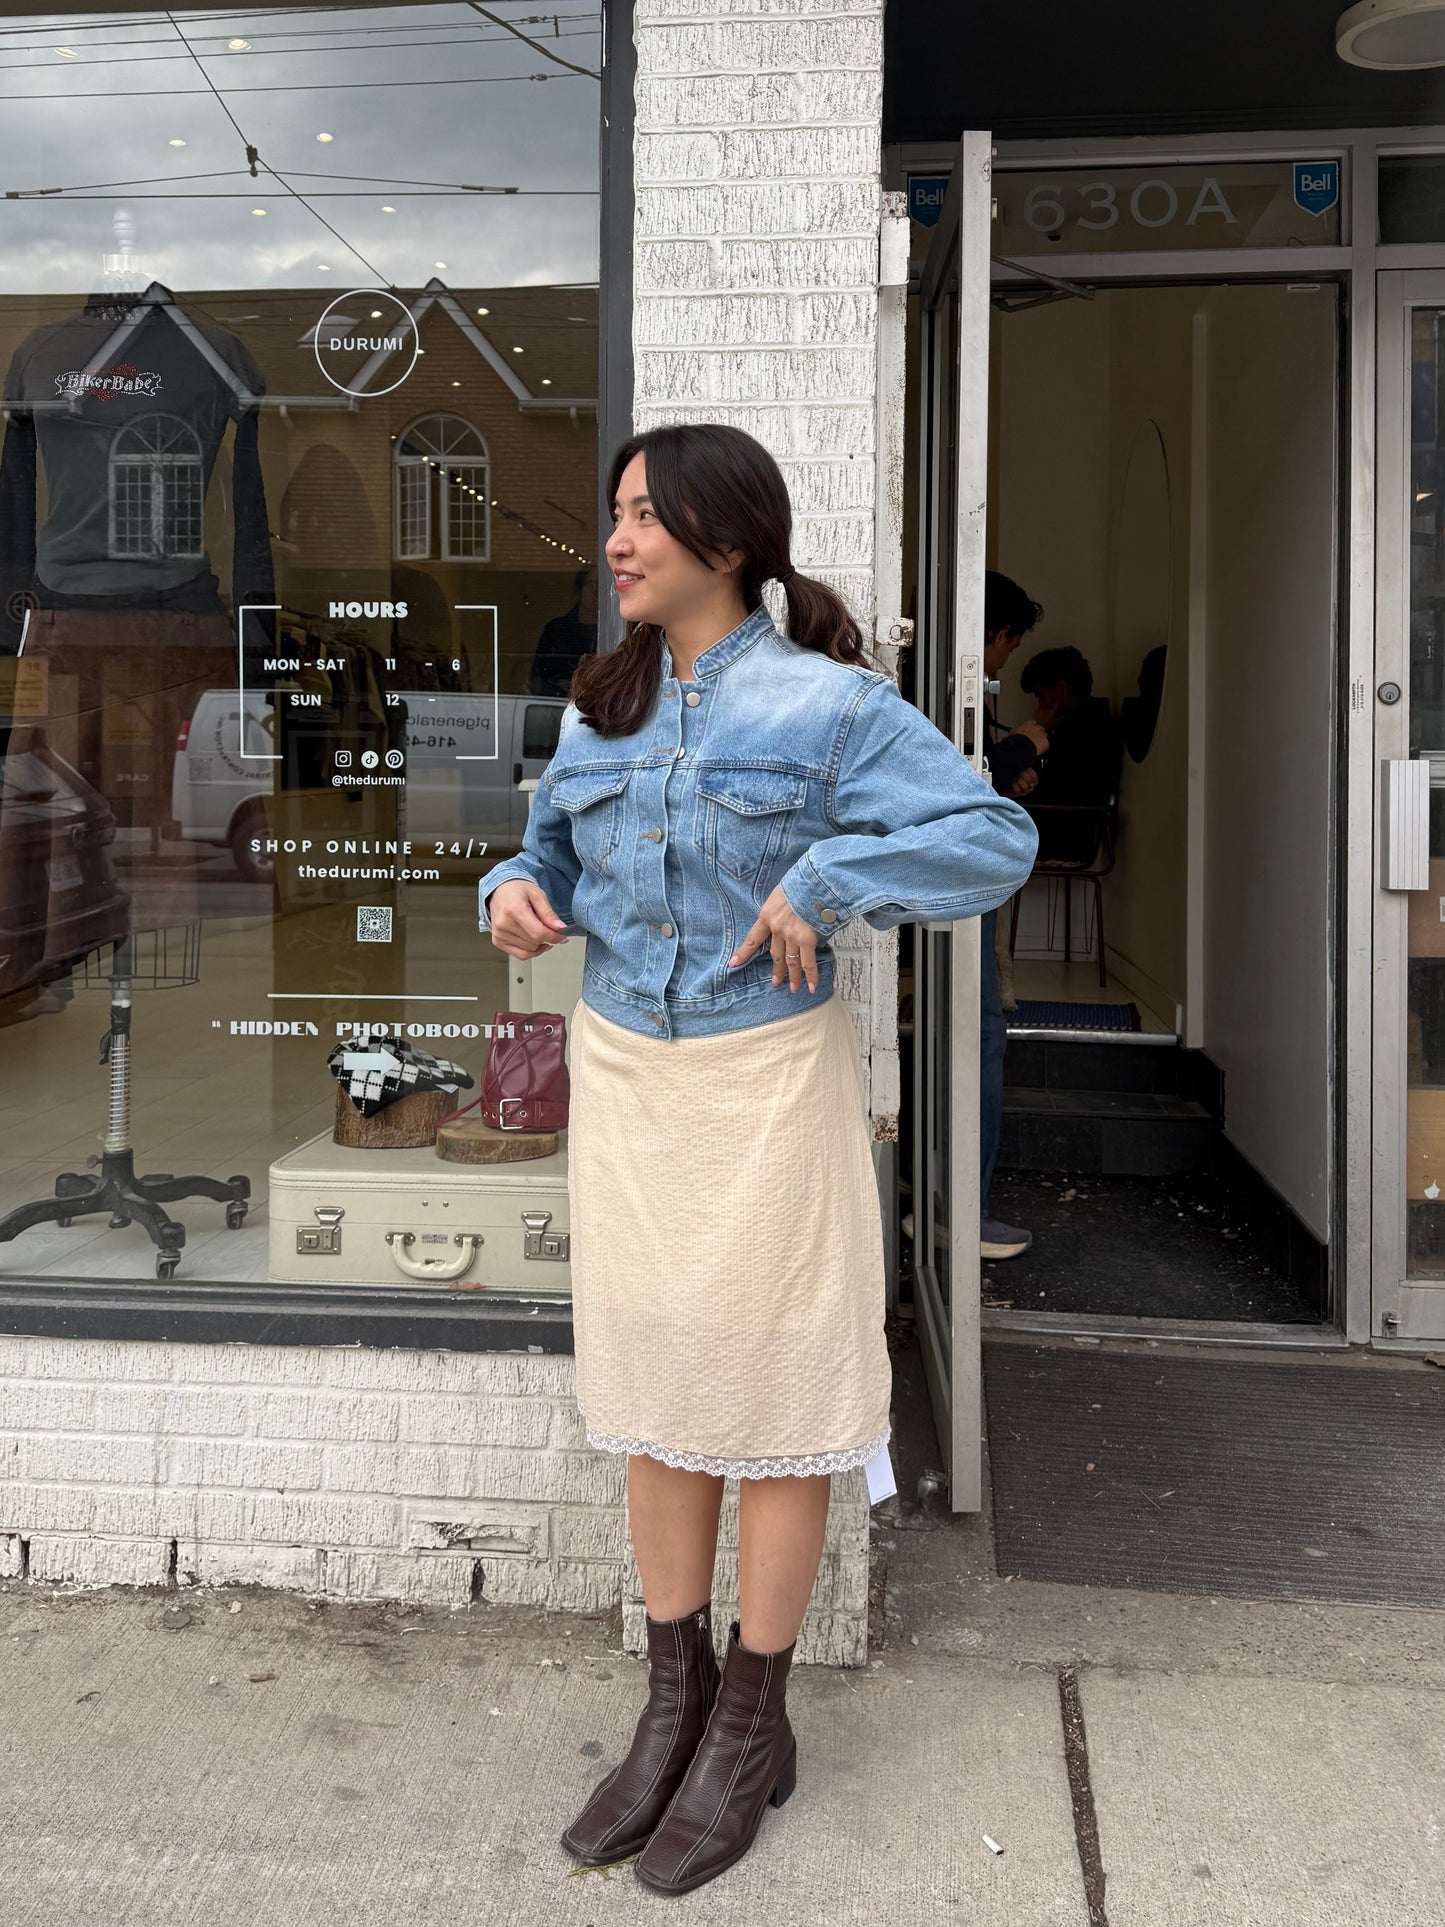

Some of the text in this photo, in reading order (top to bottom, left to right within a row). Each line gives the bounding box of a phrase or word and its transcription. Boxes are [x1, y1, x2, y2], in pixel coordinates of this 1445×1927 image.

[1301, 173, 1331, 192] Bell
[915, 188, 944, 206] Bell
[1023, 177, 1238, 232] 630A
[330, 337, 403, 351] DURUMI
[329, 601, 408, 619] HOURS
[385, 658, 396, 670] 11
[452, 658, 460, 671] 6
[290, 694, 322, 706] SUN
[385, 693, 400, 706] 12
[331, 774, 406, 787] @thedurumi
[250, 838, 488, 858] SHOP ONLINE 24/7
[298, 864, 440, 881] thedurumi.com
[230, 1020, 319, 1036] HIDDEN
[336, 1022, 515, 1039] PHOTOBOOTH
